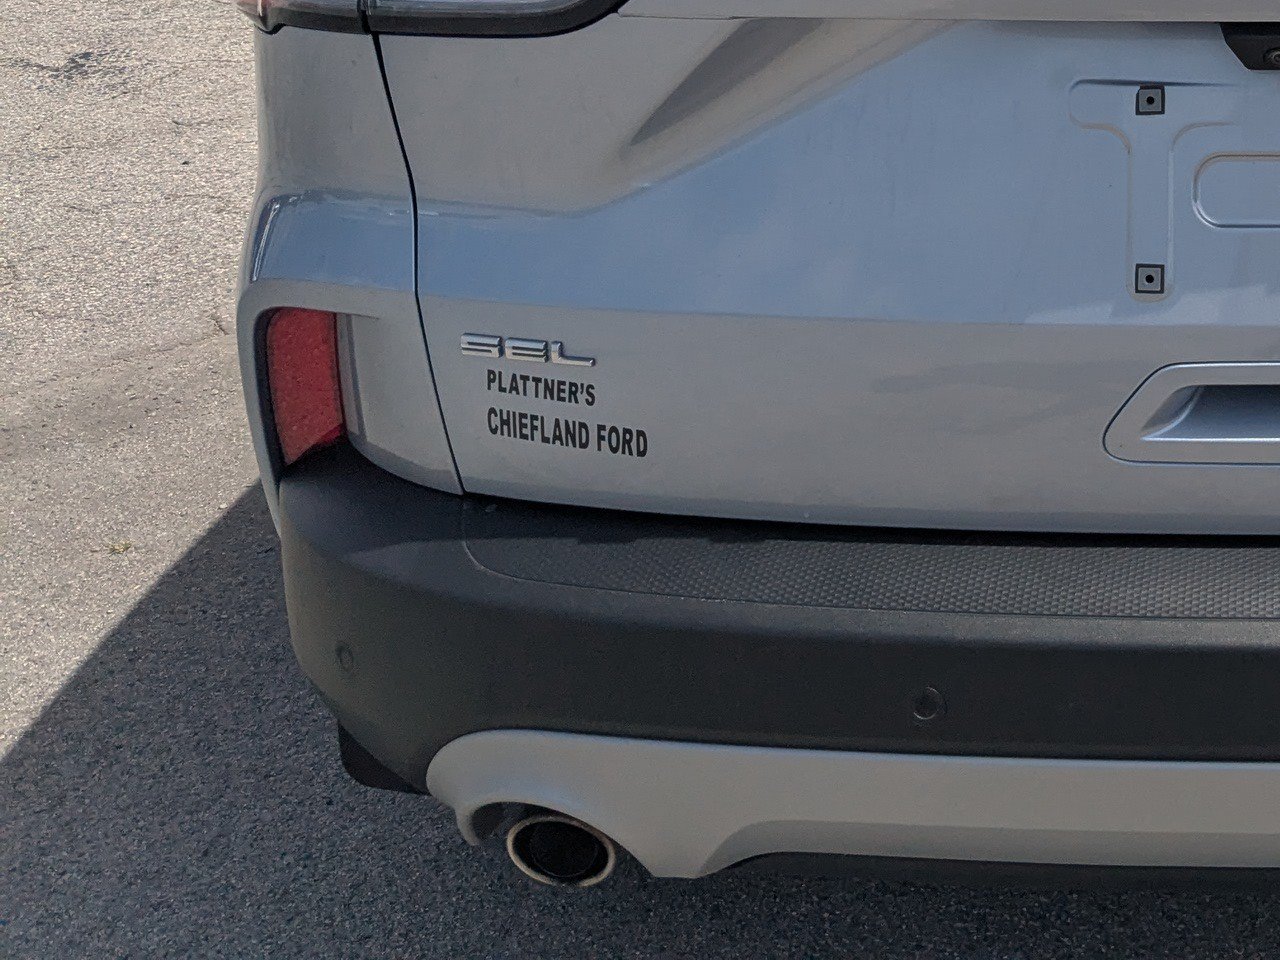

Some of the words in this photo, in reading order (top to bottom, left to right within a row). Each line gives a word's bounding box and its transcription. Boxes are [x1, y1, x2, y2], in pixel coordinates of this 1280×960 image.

[460, 332, 596, 367] SEL
[487, 369, 596, 406] PLATTNER'S
[487, 407, 590, 450] CHIEFLAND
[596, 423, 648, 458] FORD
